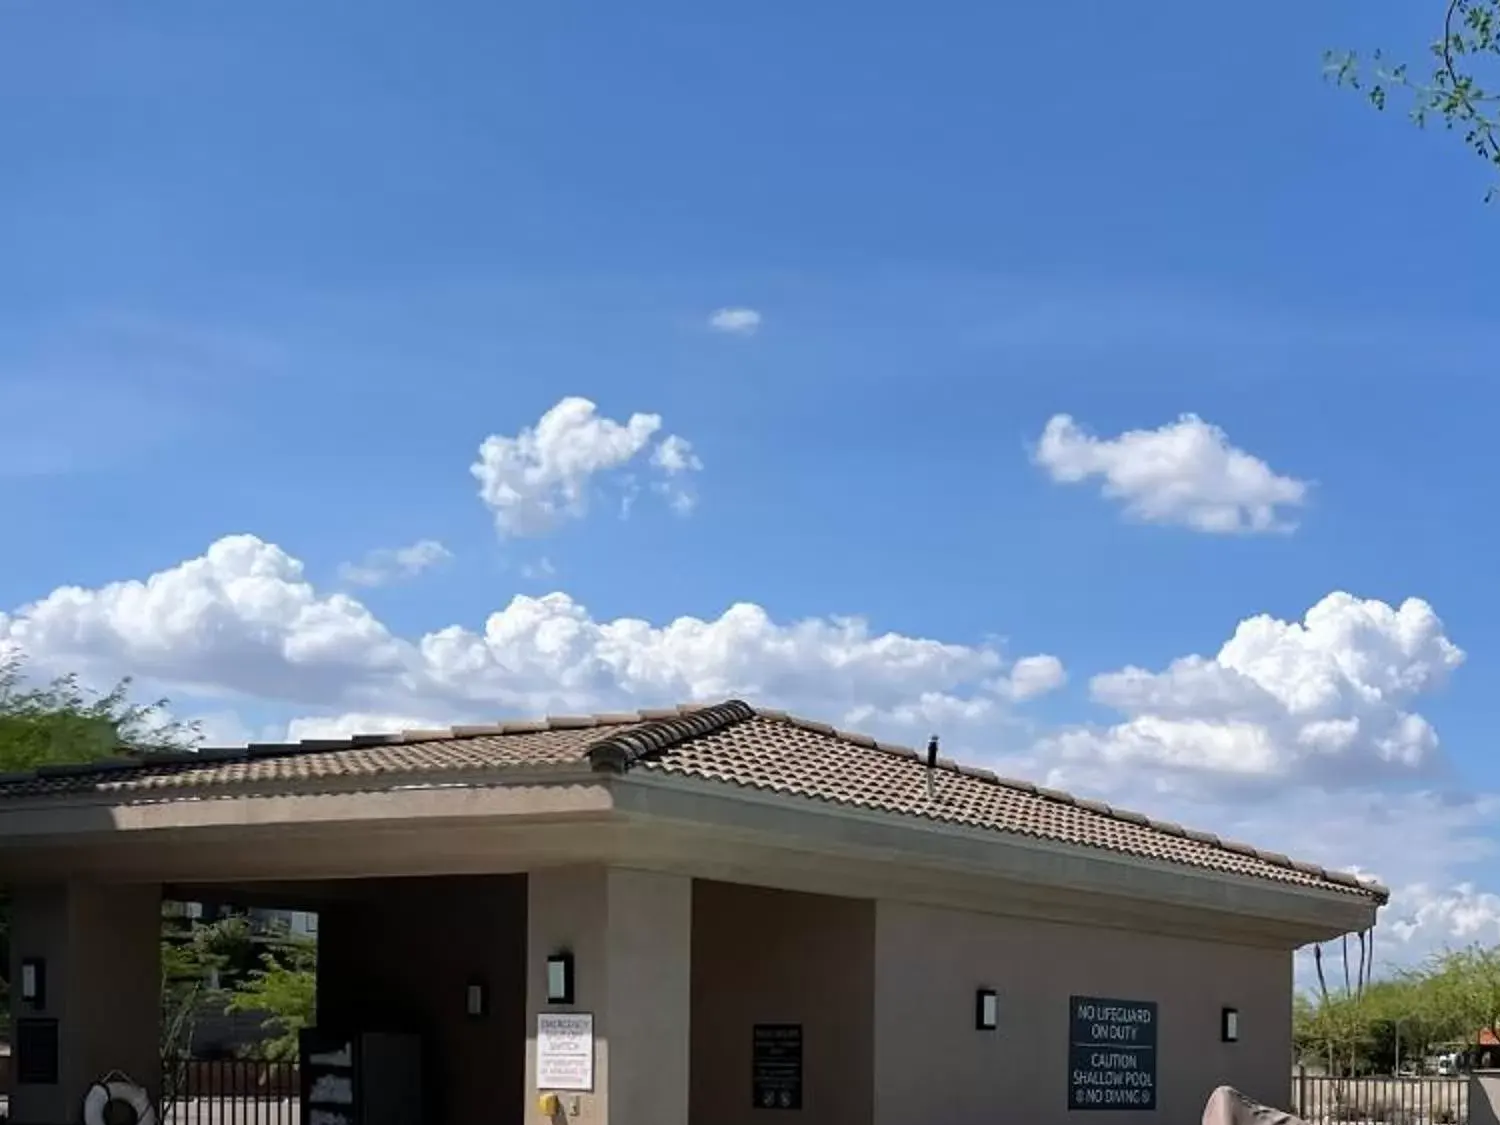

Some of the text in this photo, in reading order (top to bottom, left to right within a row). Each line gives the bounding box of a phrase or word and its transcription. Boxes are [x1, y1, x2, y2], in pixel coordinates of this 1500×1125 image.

[1078, 1005, 1151, 1023] NO LIFEGUARD
[1091, 1024, 1137, 1040] ON DUTY
[1091, 1053, 1137, 1069] CAUTION
[1073, 1070, 1153, 1087] SHALLOW POOL
[1087, 1089, 1140, 1104] NO DIVING
